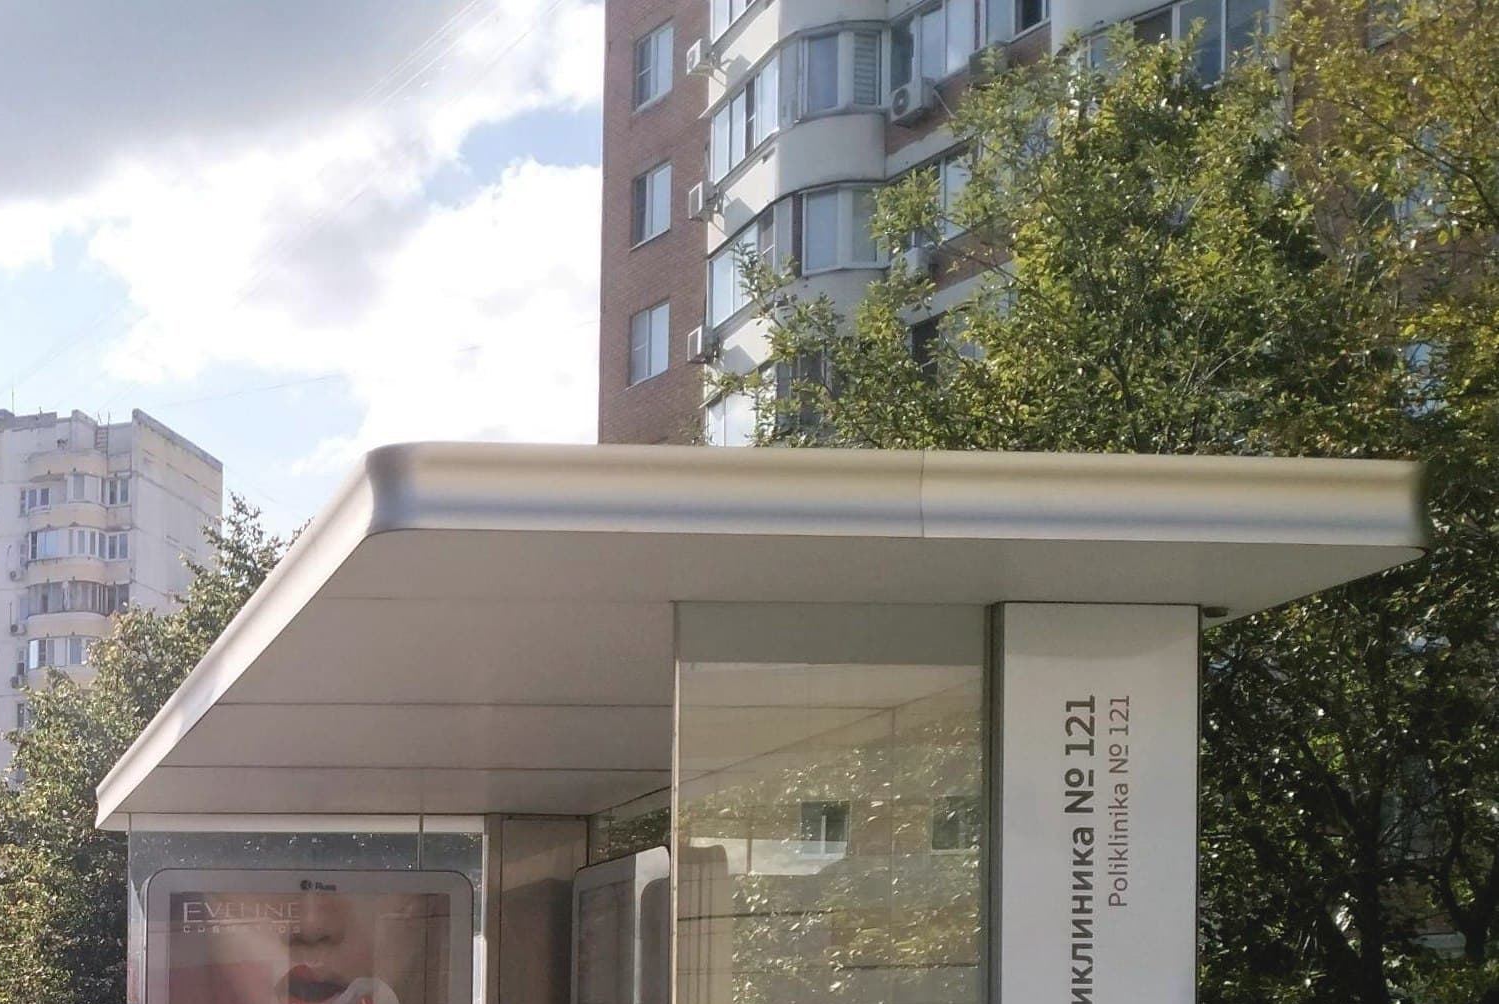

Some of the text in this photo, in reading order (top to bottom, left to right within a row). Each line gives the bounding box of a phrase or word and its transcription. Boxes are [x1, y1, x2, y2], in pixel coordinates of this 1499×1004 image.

[1065, 694, 1097, 758] 121
[1064, 767, 1096, 815] №
[1108, 694, 1131, 908] Poliklinika № 121
[183, 902, 301, 923] EVELINE
